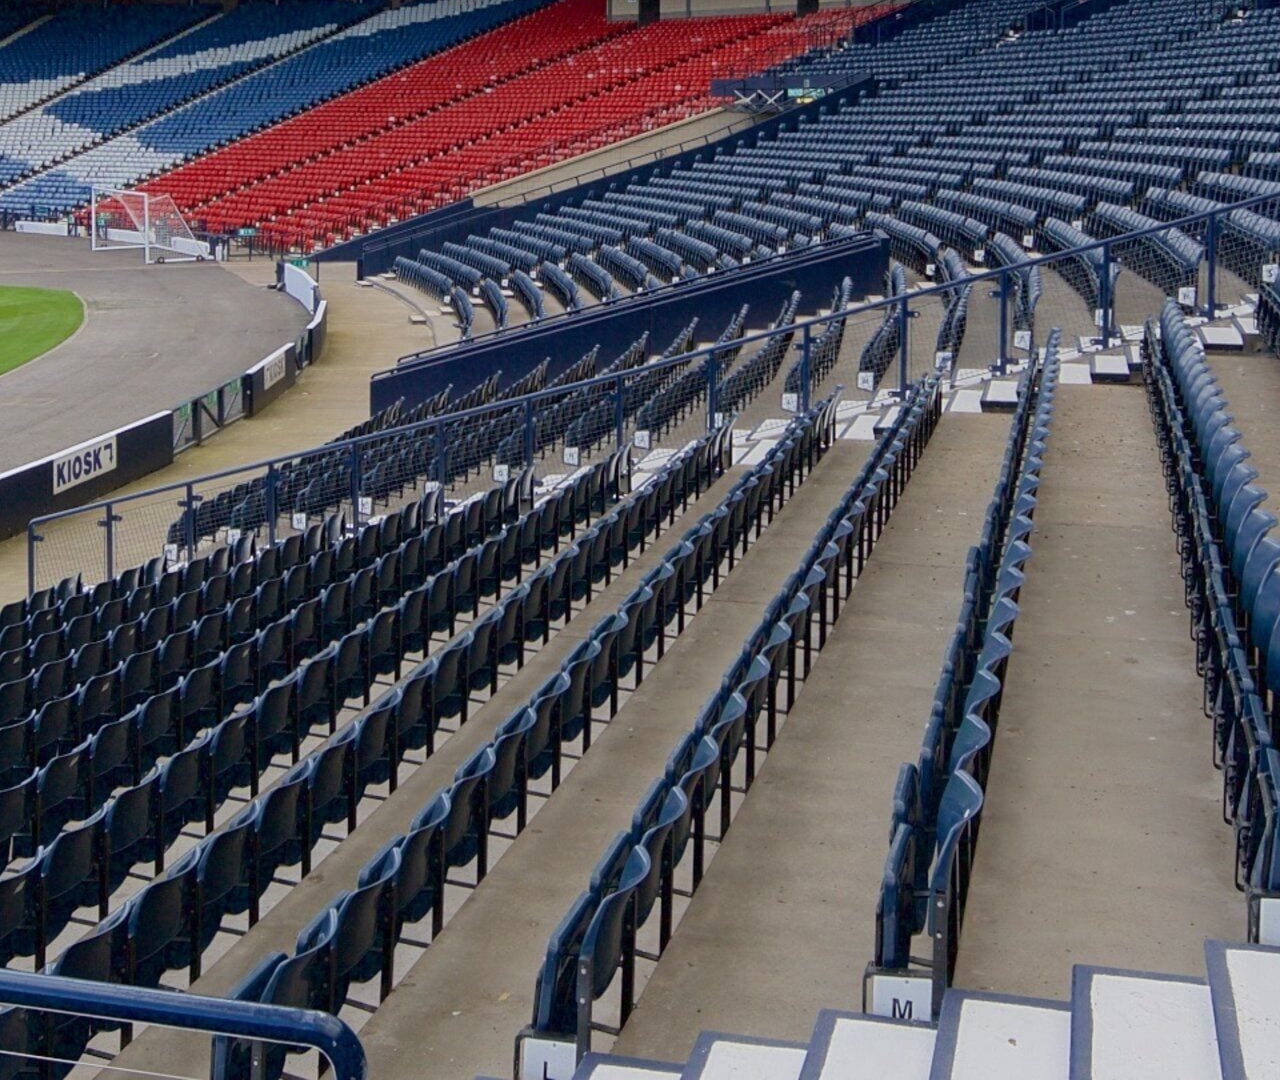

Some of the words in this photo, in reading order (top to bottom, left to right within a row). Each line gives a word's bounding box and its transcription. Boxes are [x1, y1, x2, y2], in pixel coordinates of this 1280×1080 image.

[56, 451, 104, 489] KIOSK
[892, 997, 913, 1019] M
[543, 1061, 555, 1080] L
